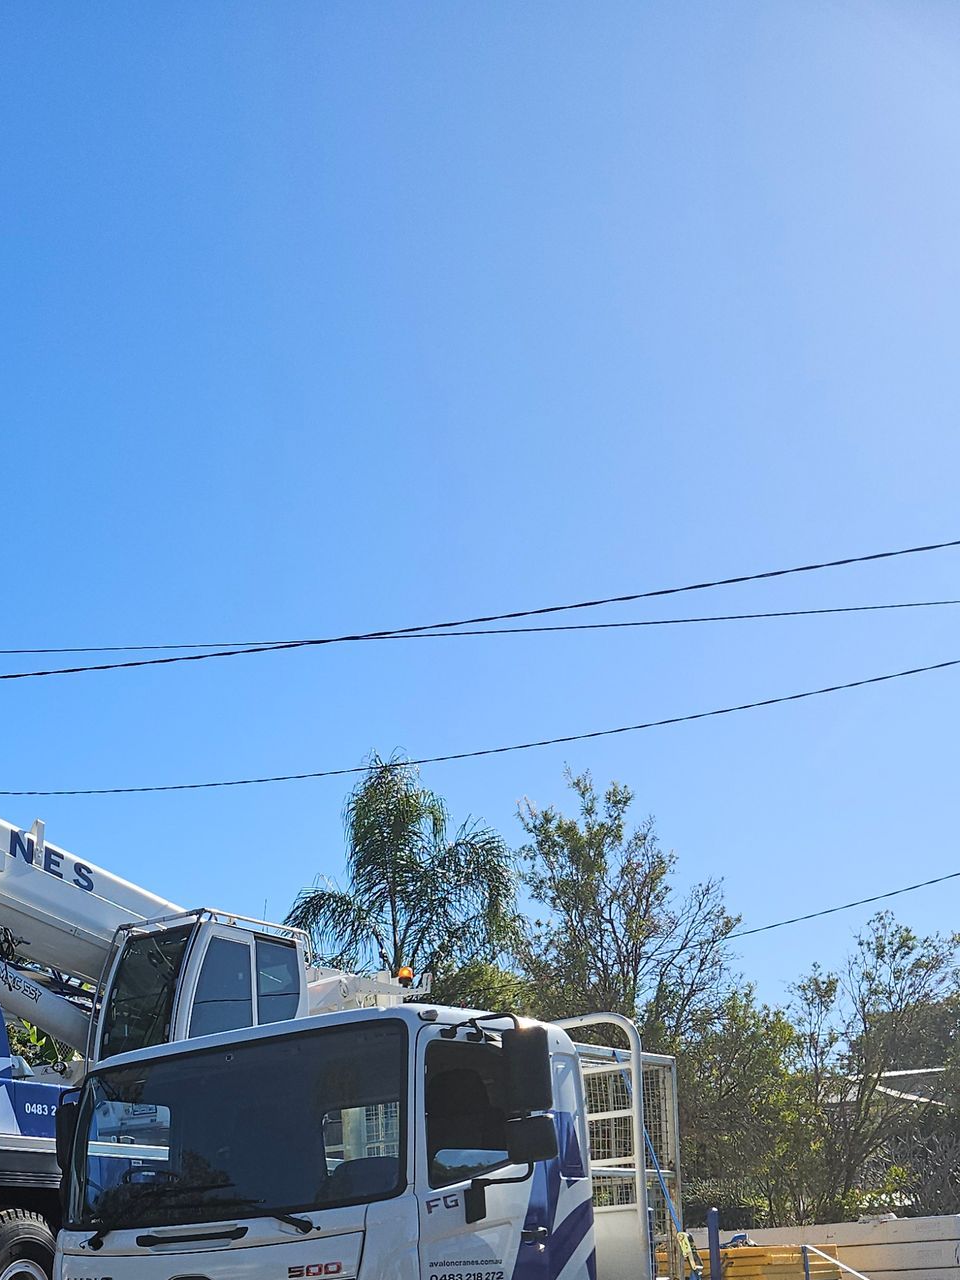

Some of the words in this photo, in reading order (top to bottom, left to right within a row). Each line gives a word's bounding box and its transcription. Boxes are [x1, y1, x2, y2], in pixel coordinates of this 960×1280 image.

[25, 1102, 48, 1116] 0483
[425, 1193, 460, 1214] FG
[288, 1261, 342, 1279] 500
[485, 1271, 504, 1280] 272
